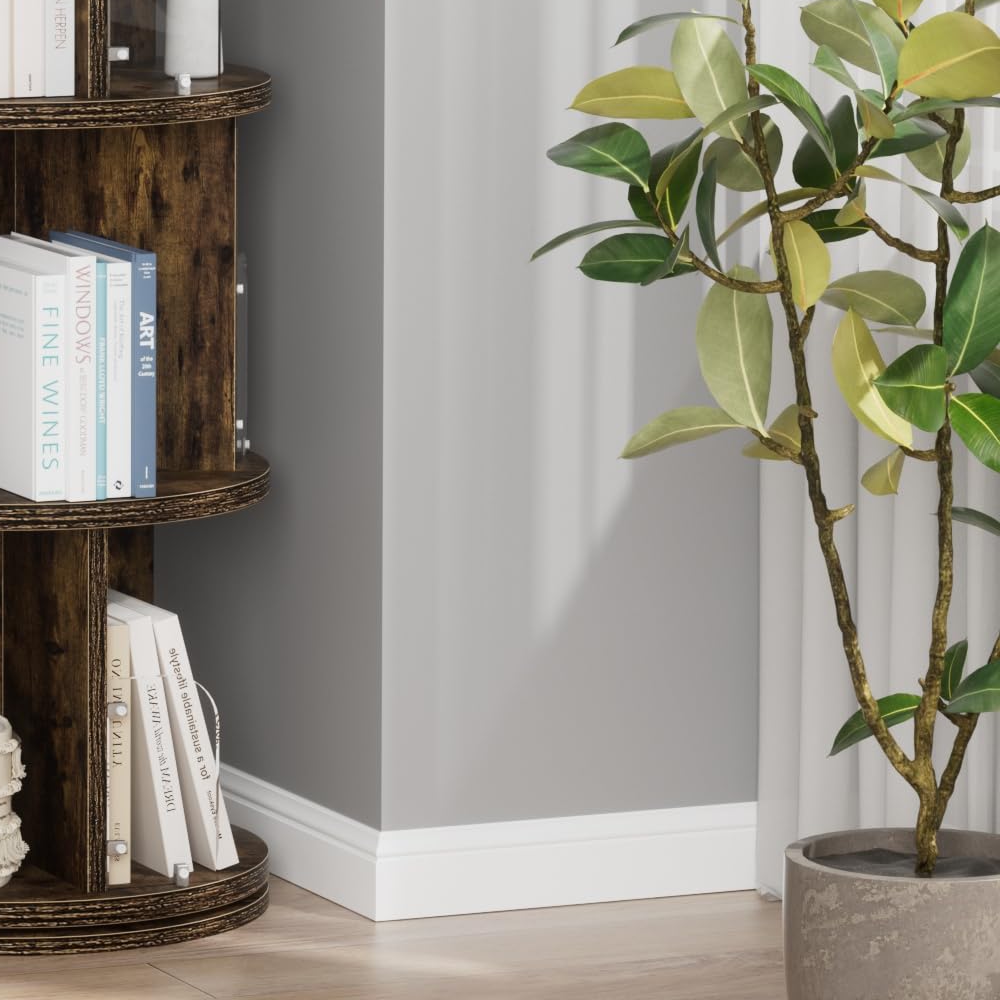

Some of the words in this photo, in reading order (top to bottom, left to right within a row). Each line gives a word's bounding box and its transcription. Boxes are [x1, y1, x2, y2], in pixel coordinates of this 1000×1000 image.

[55, 7, 67, 50] HERPEN
[41, 306, 59, 368] FINE
[75, 264, 92, 365] WINDOWS
[138, 311, 155, 350] ART
[41, 379, 59, 471] WINES
